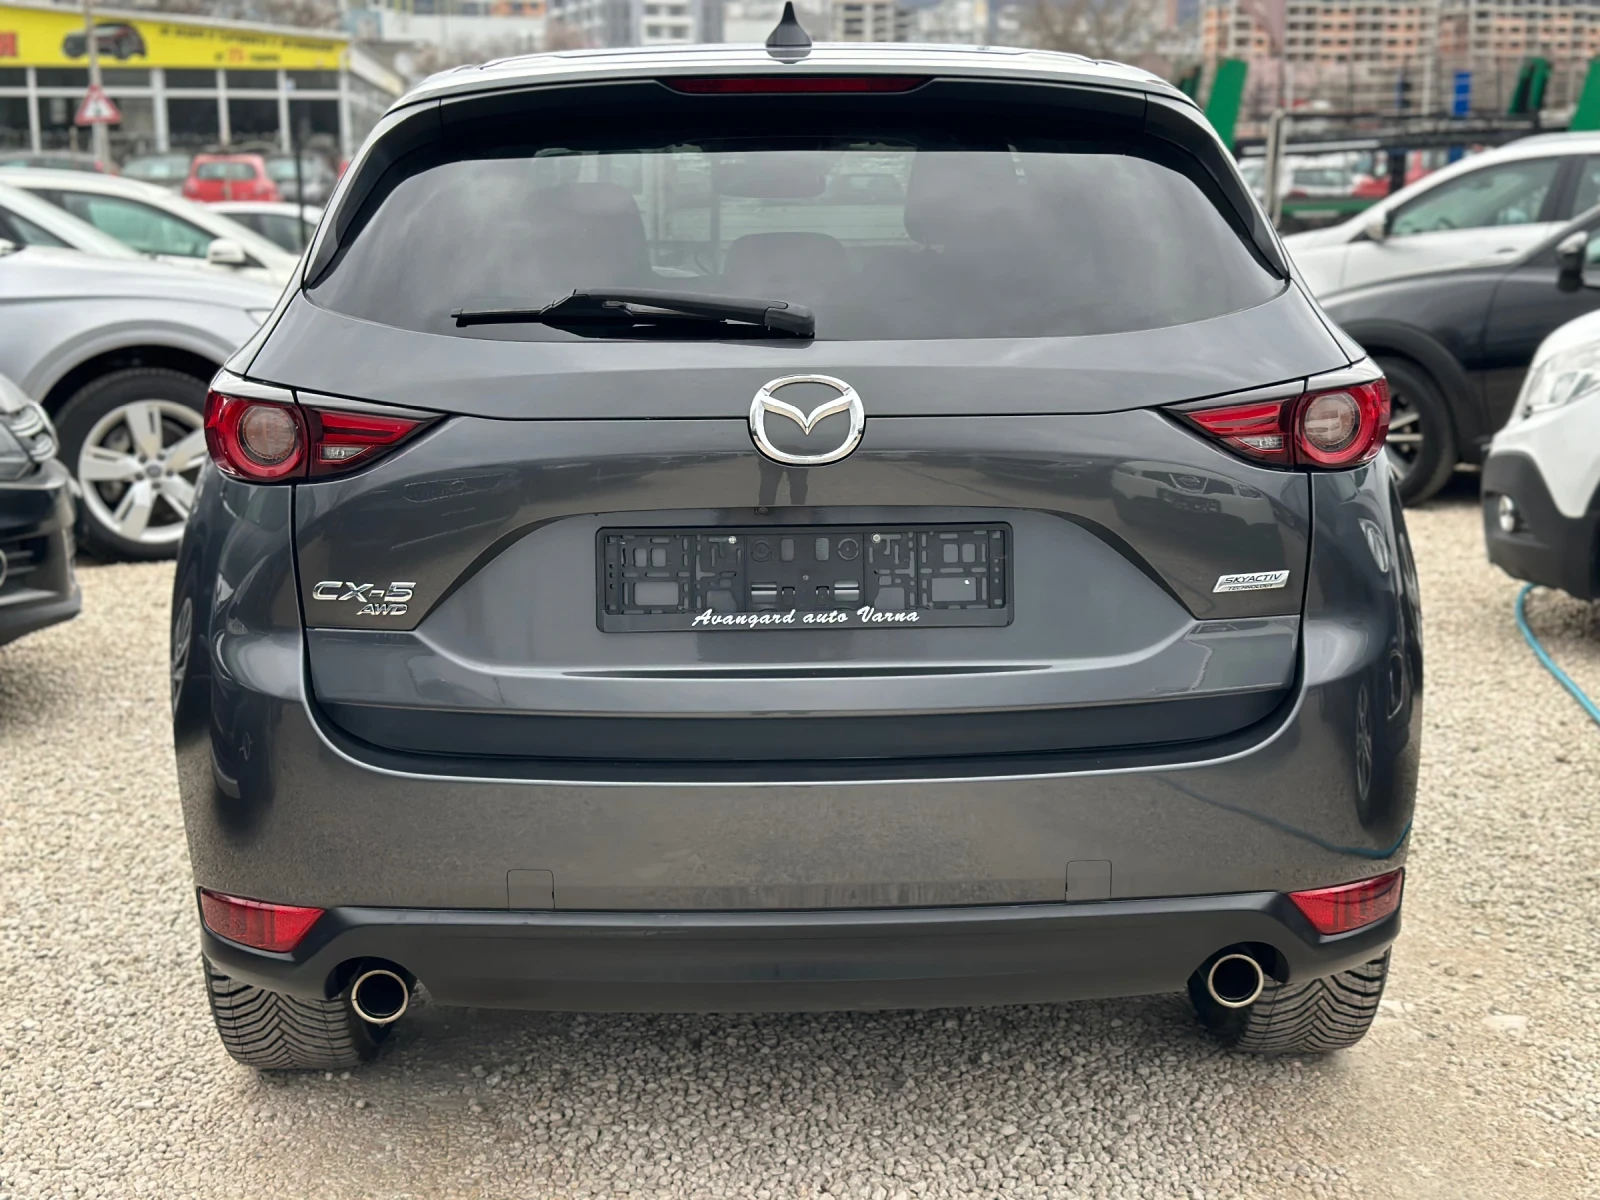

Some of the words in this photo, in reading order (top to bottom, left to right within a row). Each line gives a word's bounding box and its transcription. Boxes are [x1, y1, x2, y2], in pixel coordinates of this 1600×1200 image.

[1223, 573, 1283, 584] SKYACTIV
[312, 581, 417, 603] CX-5
[356, 603, 408, 616] AWD
[691, 608, 796, 628] Avangard
[802, 609, 849, 624] auto
[856, 605, 920, 624] Varna
